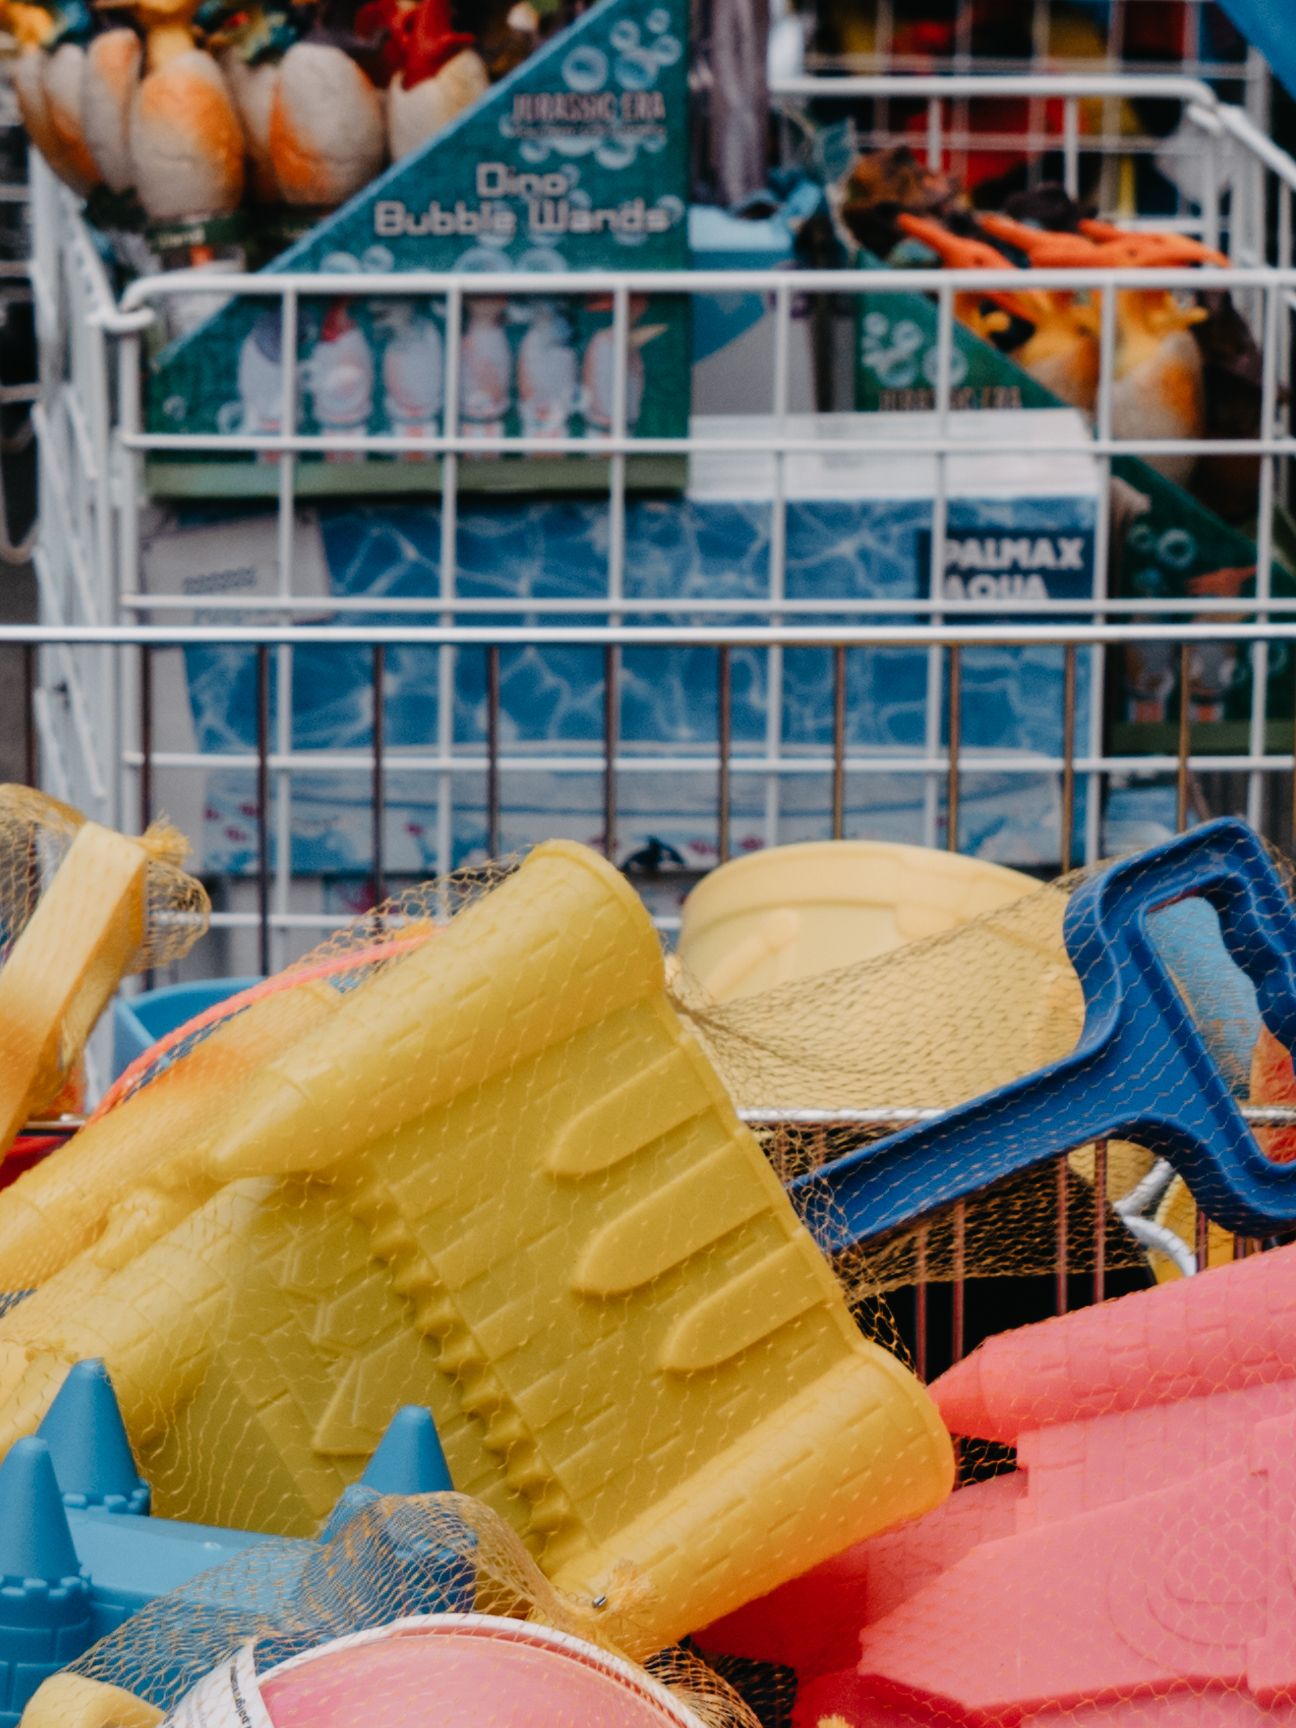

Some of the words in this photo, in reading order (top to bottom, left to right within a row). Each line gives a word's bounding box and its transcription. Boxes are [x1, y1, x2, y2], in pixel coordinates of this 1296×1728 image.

[622, 91, 666, 120] ERA
[476, 162, 567, 198] Dino
[374, 200, 517, 237] Bubble
[528, 197, 670, 233] Wands
[945, 537, 1084, 571] PALMAX
